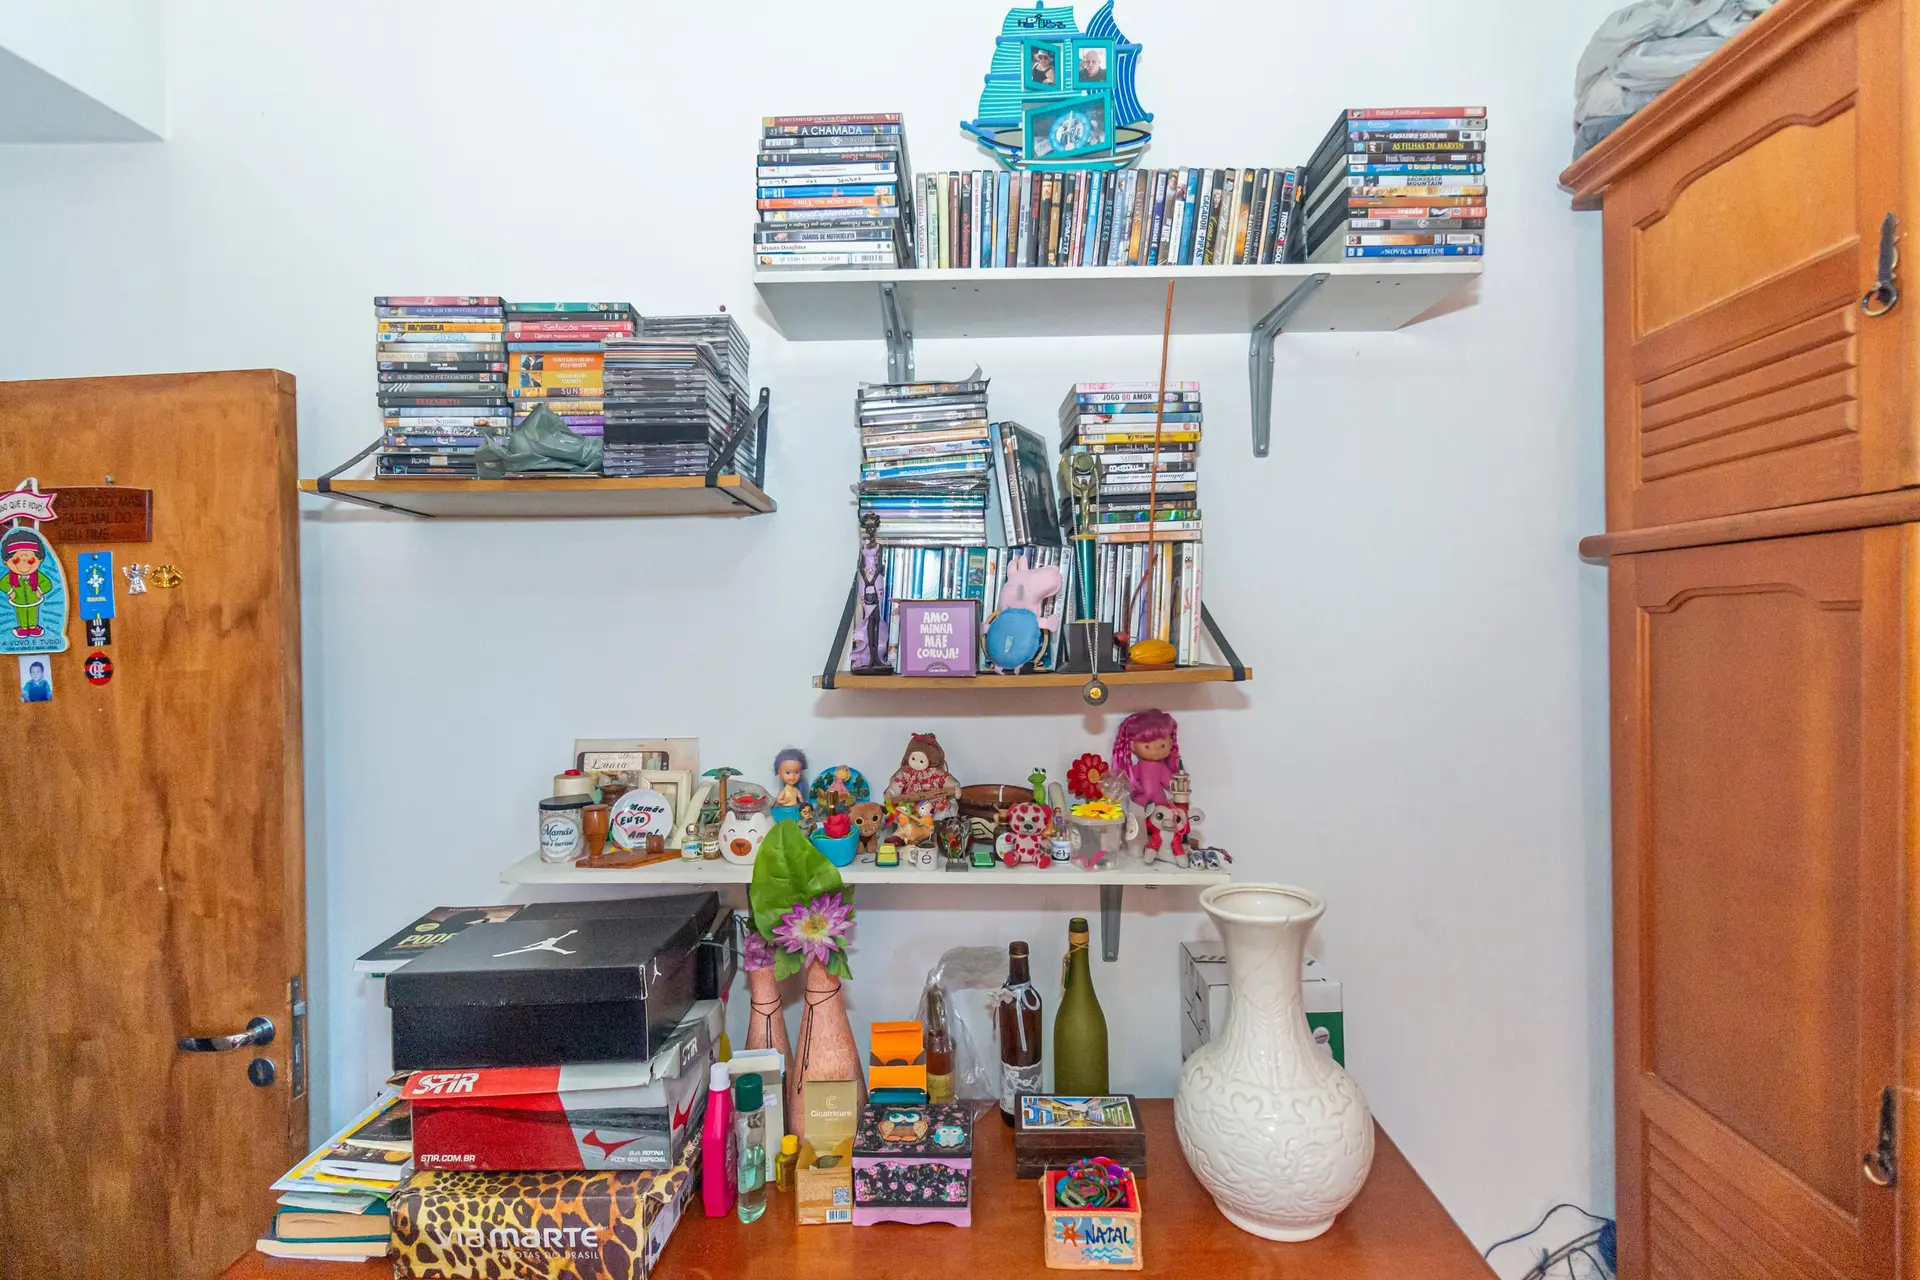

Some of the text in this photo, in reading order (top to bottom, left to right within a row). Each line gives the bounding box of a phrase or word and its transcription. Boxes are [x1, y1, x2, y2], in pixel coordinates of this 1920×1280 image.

[801, 126, 863, 135] A CHAMADA
[1401, 142, 1425, 150] FILHAS
[1102, 200, 1113, 242] BEE GEES
[1268, 200, 1279, 235] AVATAR
[1195, 195, 1210, 258] CAÇADOR PIPAS
[1274, 246, 1283, 264] ISOL
[542, 323, 579, 331] Sedução
[561, 387, 604, 395] SUNSHINE
[1108, 463, 1146, 472] BABEL
[9, 501, 21, 510] QUE
[118, 495, 144, 507] MAS
[62, 511, 132, 524] FALE MAL DO
[58, 529, 82, 541] MEU
[923, 611, 949, 623] AMO
[920, 623, 953, 635] MINHA
[924, 634, 948, 648] MÃE
[916, 647, 960, 659] CORUJA!
[592, 757, 628, 770] Laura
[629, 803, 665, 814] Mamãe
[620, 815, 646, 825] Eu Te
[541, 823, 575, 840] Mamãe
[683, 1037, 698, 1066] STIR
[412, 1072, 480, 1095] STIR
[420, 1153, 476, 1163] STIR.COM.BR
[1084, 1224, 1131, 1245] NATAL
[565, 1251, 599, 1260] BRASIL
